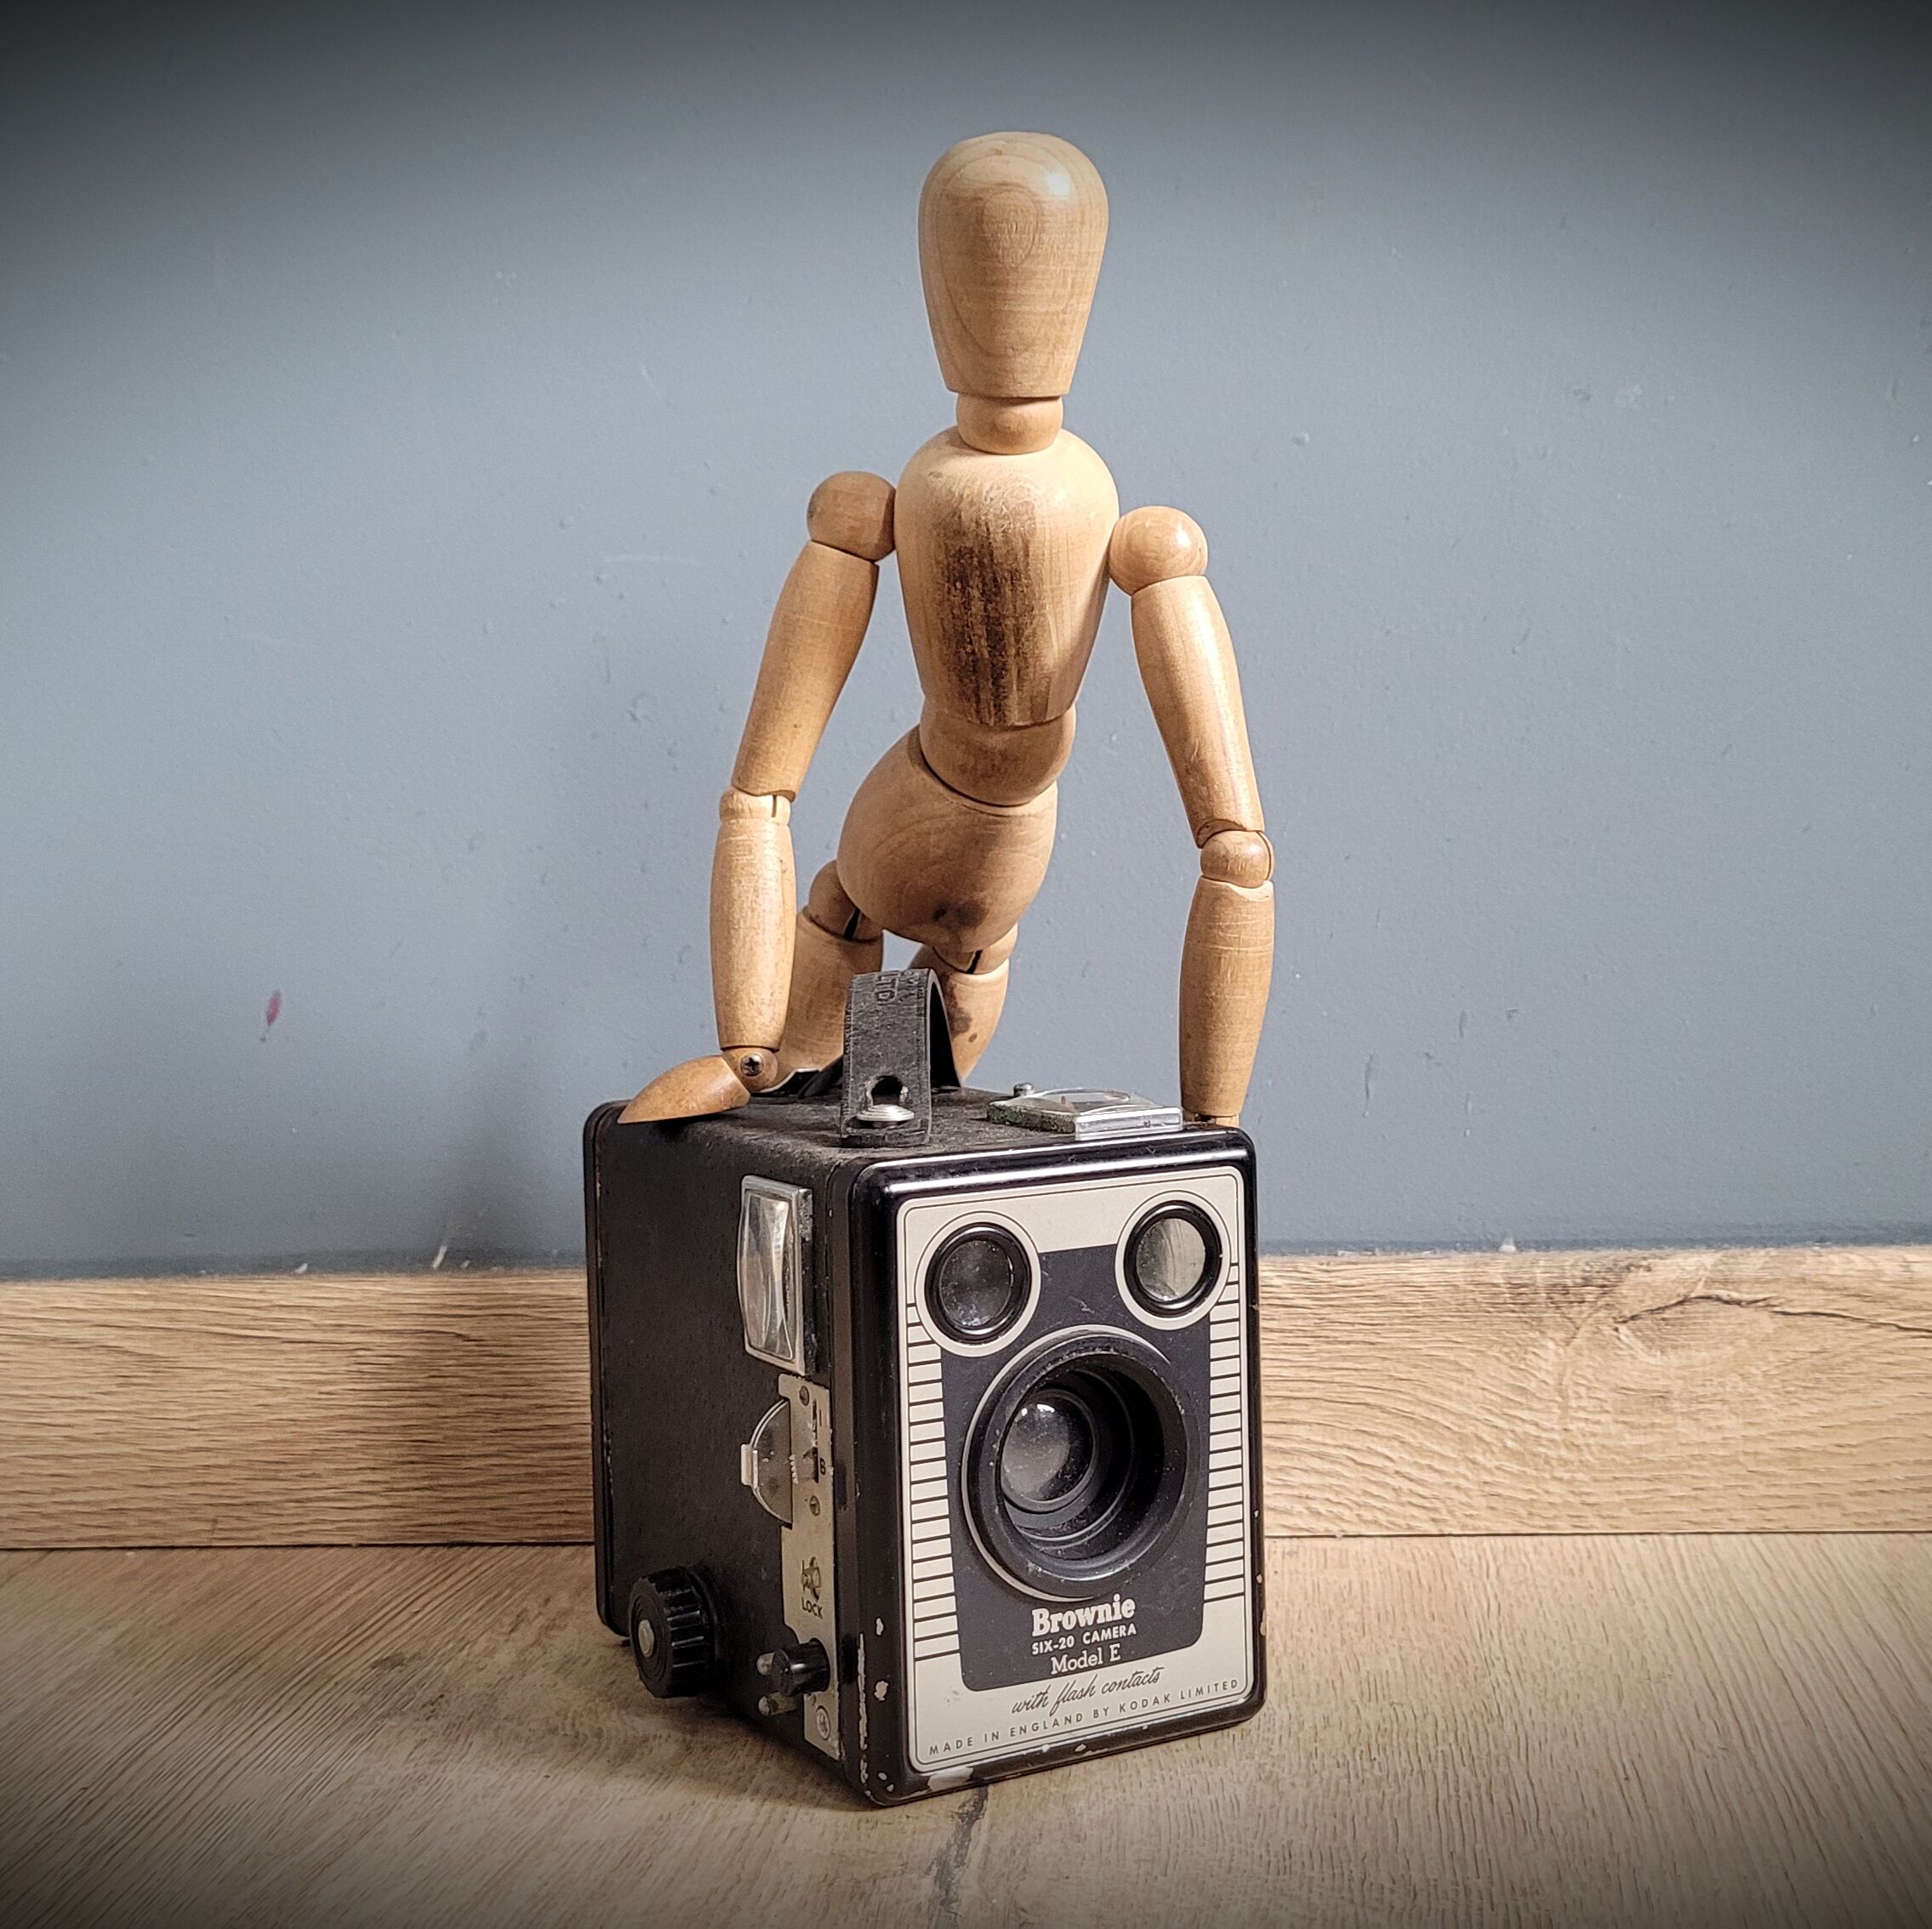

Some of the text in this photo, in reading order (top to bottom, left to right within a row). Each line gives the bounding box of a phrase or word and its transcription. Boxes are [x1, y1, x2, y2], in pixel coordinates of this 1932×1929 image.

[801, 1596, 824, 1620] LOCK
[1031, 1593, 1136, 1636] Brownie
[1031, 1623, 1137, 1655] SIX-20 CAMERA
[1050, 1642, 1121, 1675] Model E
[1011, 1666, 1165, 1716] with flash contacts
[928, 1679, 1239, 1756] MADE IN ENGLAND BY KODAK LIMITED
